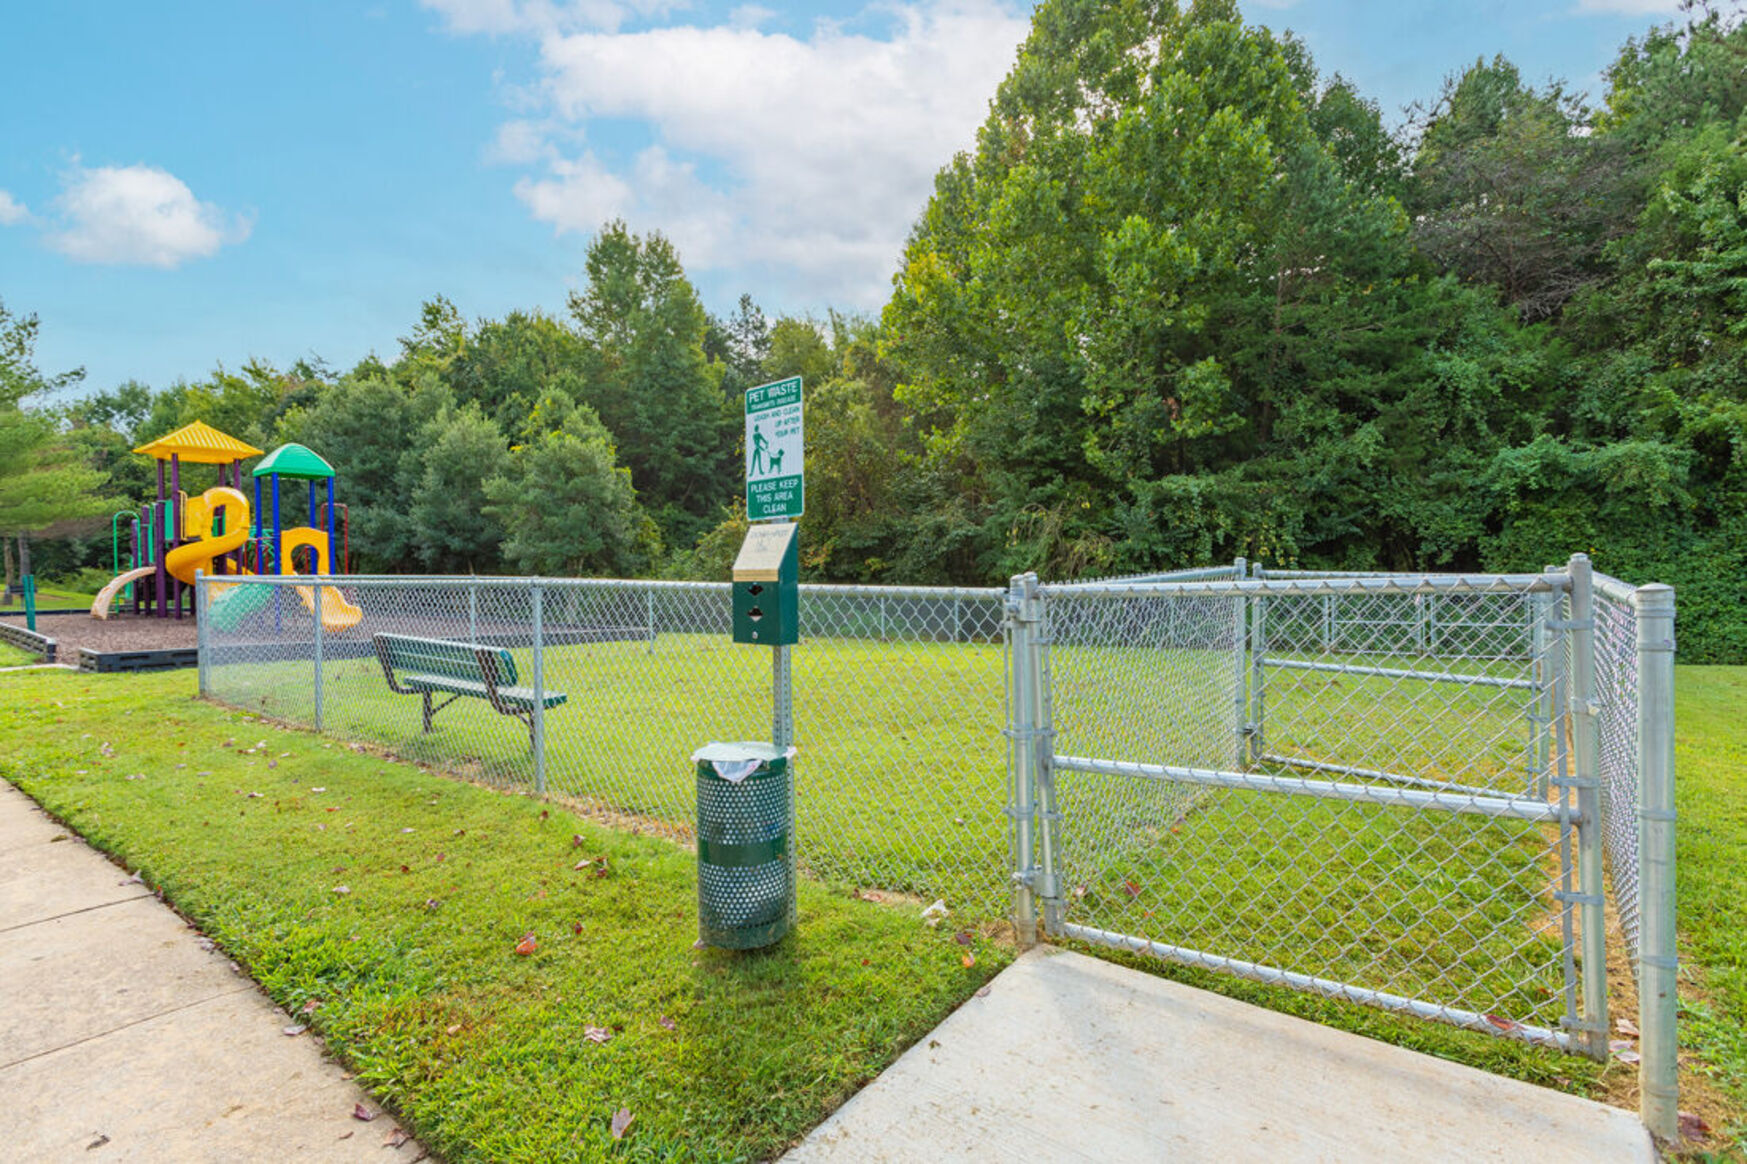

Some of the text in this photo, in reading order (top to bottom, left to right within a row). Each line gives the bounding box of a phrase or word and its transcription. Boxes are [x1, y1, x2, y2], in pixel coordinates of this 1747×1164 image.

[749, 381, 798, 403] PET WASTE
[751, 478, 799, 493] PLEASE KEEP
[756, 490, 793, 503] THIS AREA
[763, 502, 787, 514] CLEAN
